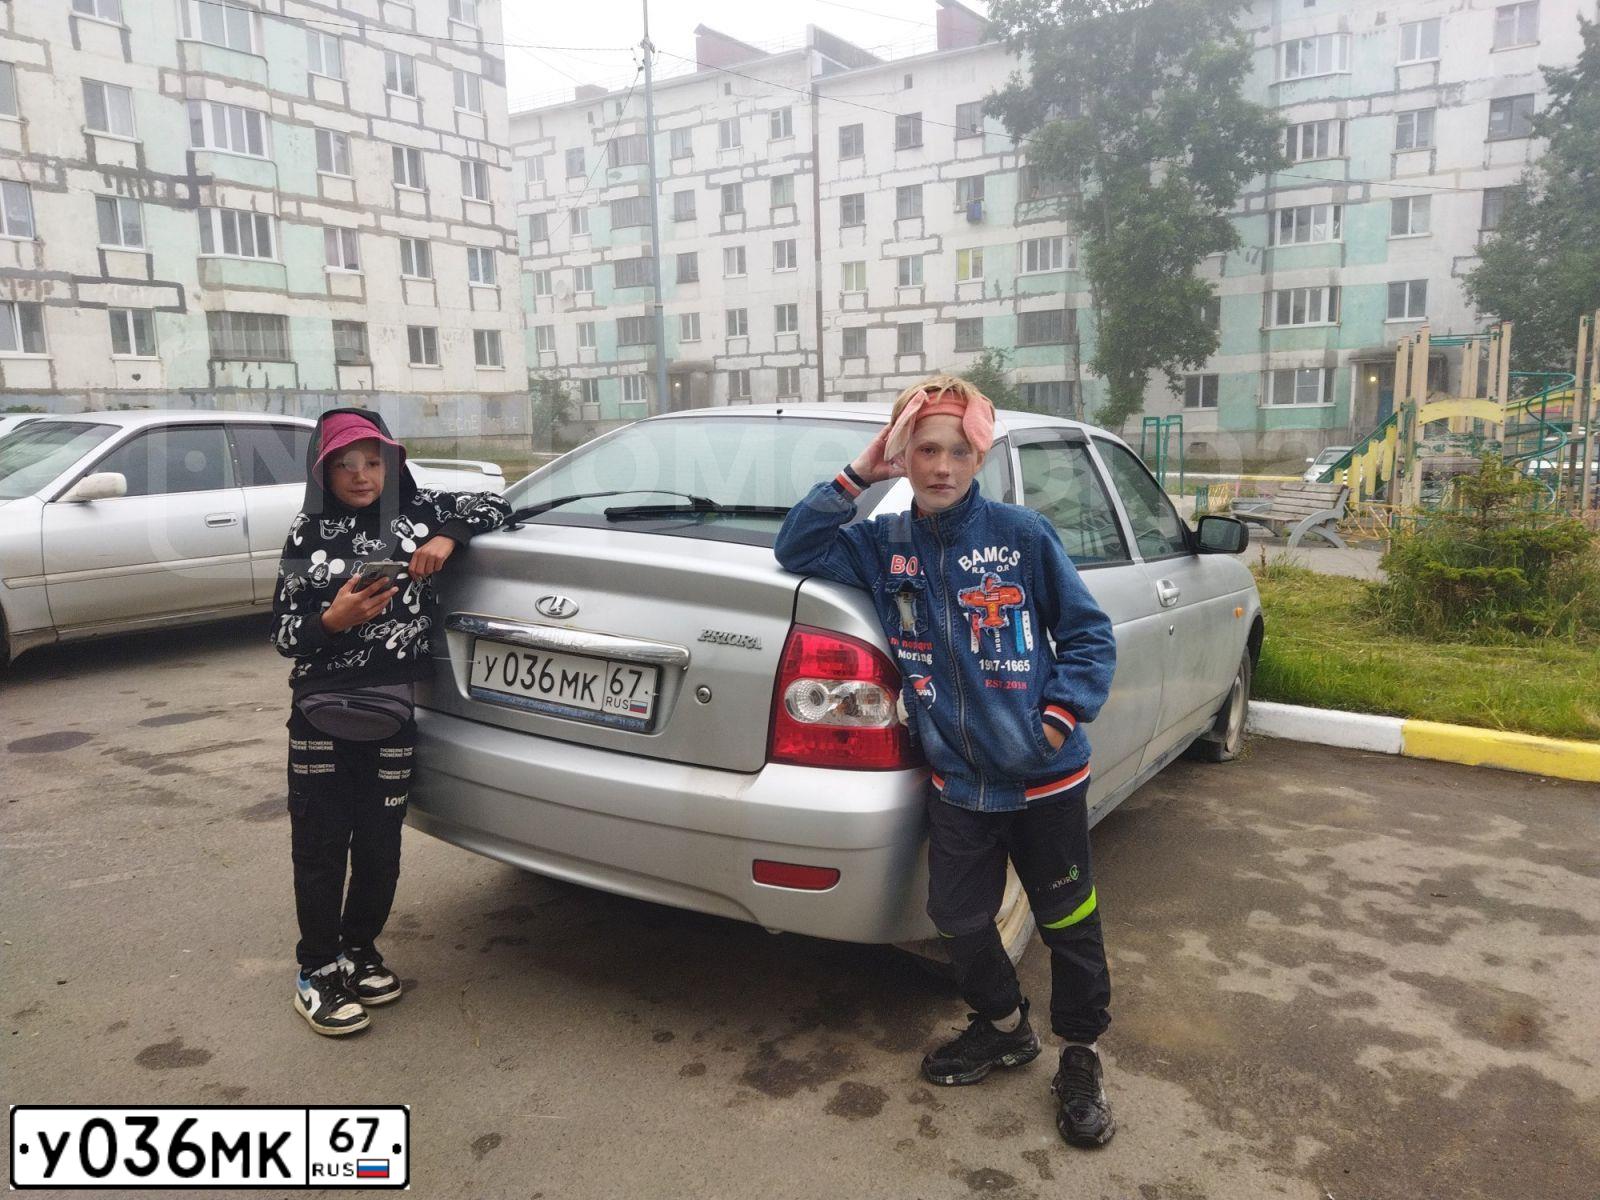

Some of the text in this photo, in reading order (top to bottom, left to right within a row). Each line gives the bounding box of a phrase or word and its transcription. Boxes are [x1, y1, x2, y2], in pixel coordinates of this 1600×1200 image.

[958, 546, 1021, 572] BAMCS
[698, 628, 762, 650] PRIORA
[609, 664, 643, 698] 67
[605, 696, 629, 710] RUS
